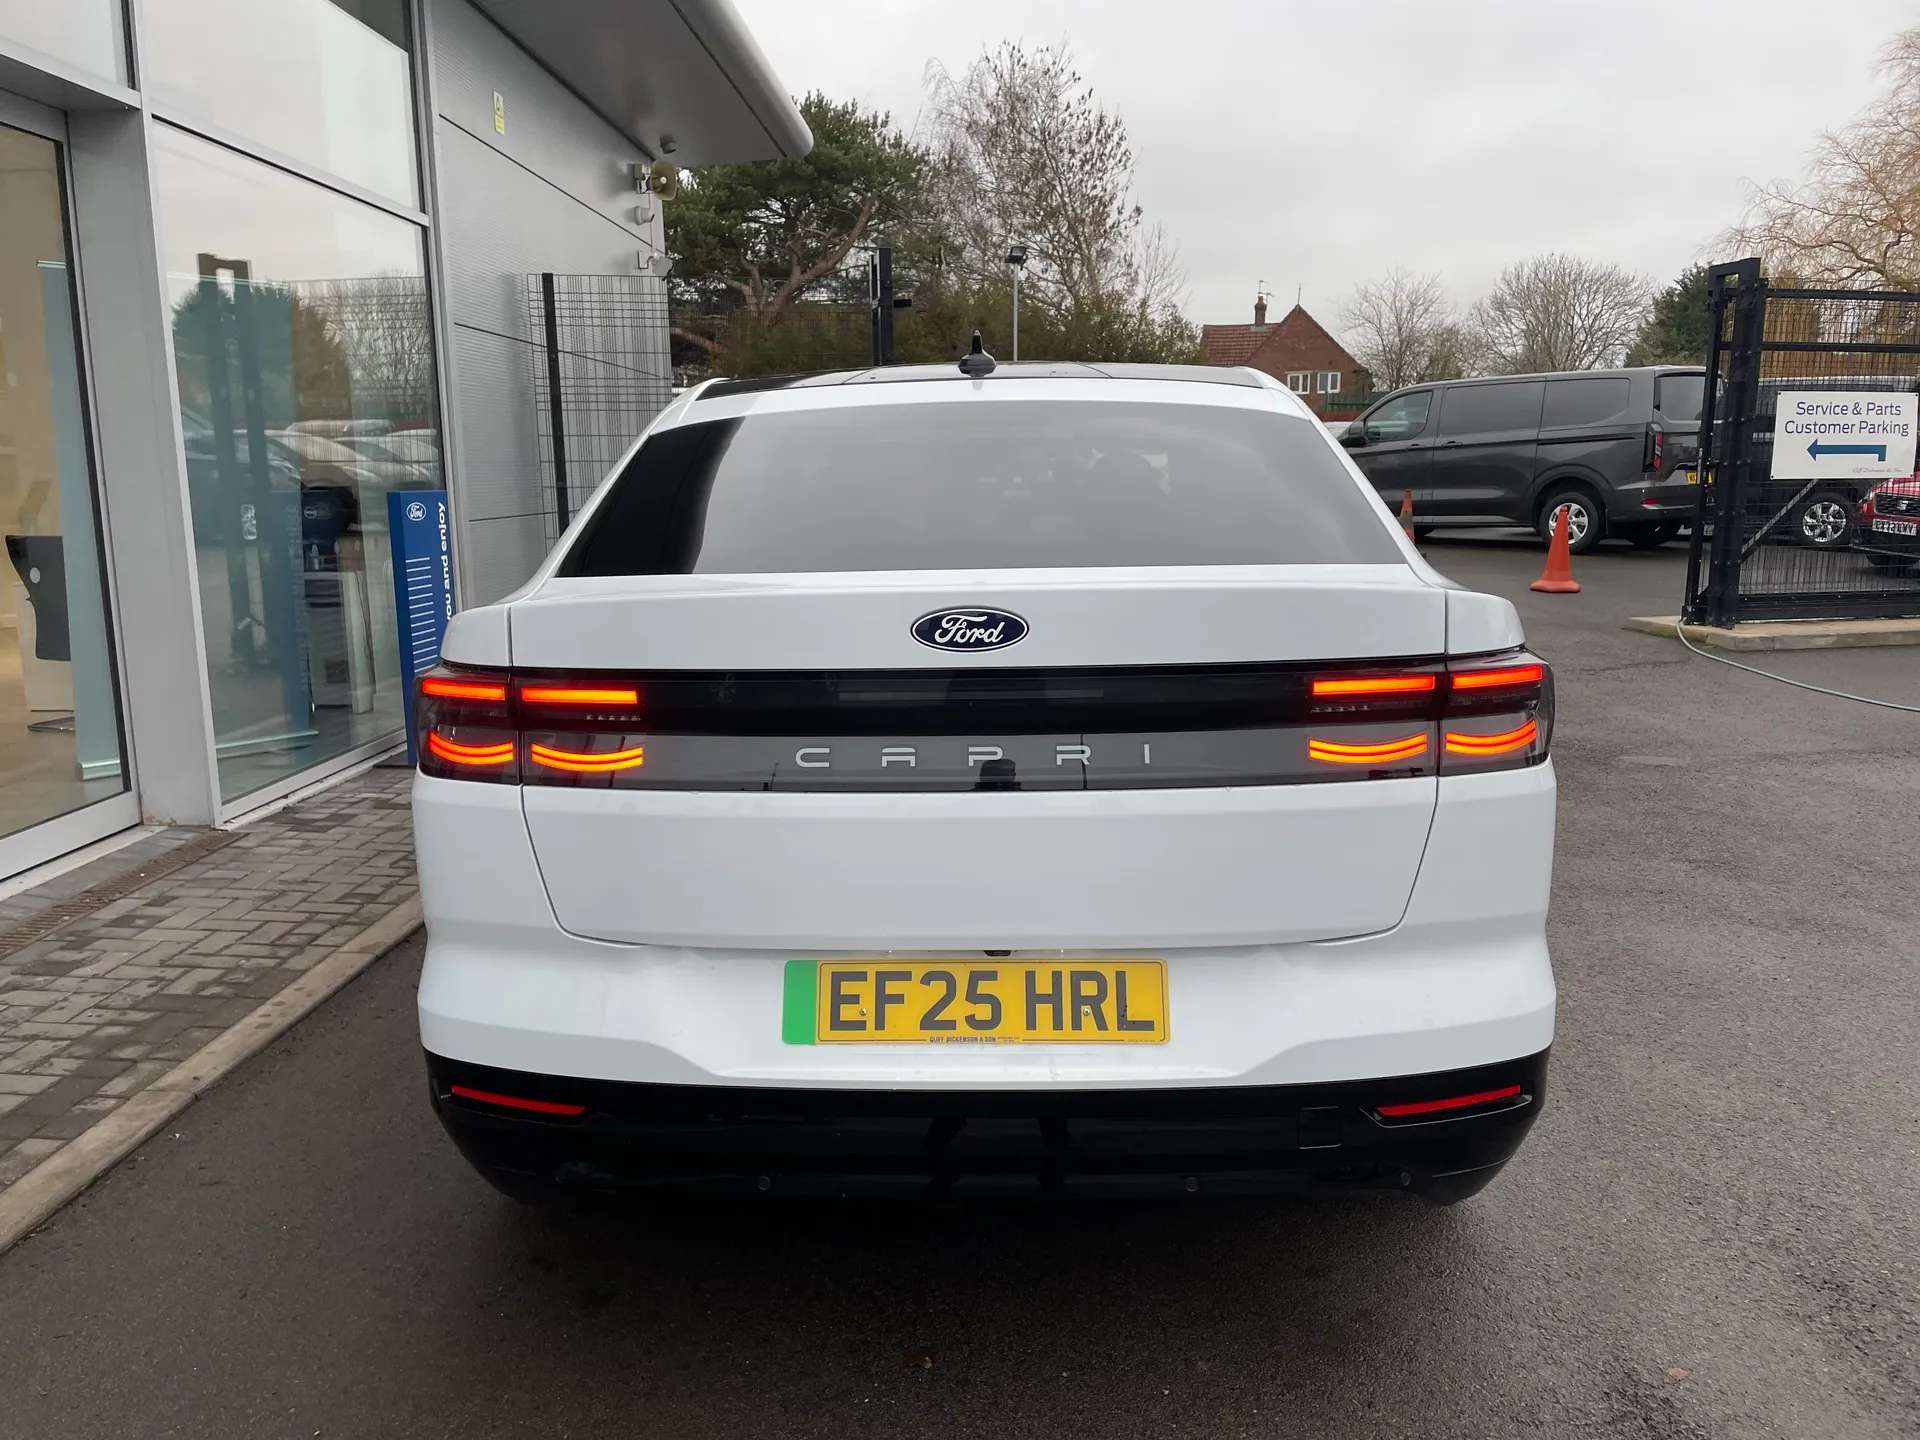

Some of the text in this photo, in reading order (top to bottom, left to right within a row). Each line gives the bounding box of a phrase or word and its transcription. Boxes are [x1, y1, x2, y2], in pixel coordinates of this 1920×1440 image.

[1795, 401, 1902, 416] Service & Parts
[1784, 420, 1909, 437] Customer Parking
[410, 503, 423, 519] Ford
[437, 502, 448, 552] enjoy
[441, 555, 451, 590] and
[934, 614, 1006, 644] Ford
[795, 743, 1150, 768] CAPRI
[829, 970, 1155, 1032] EF25 HRL
